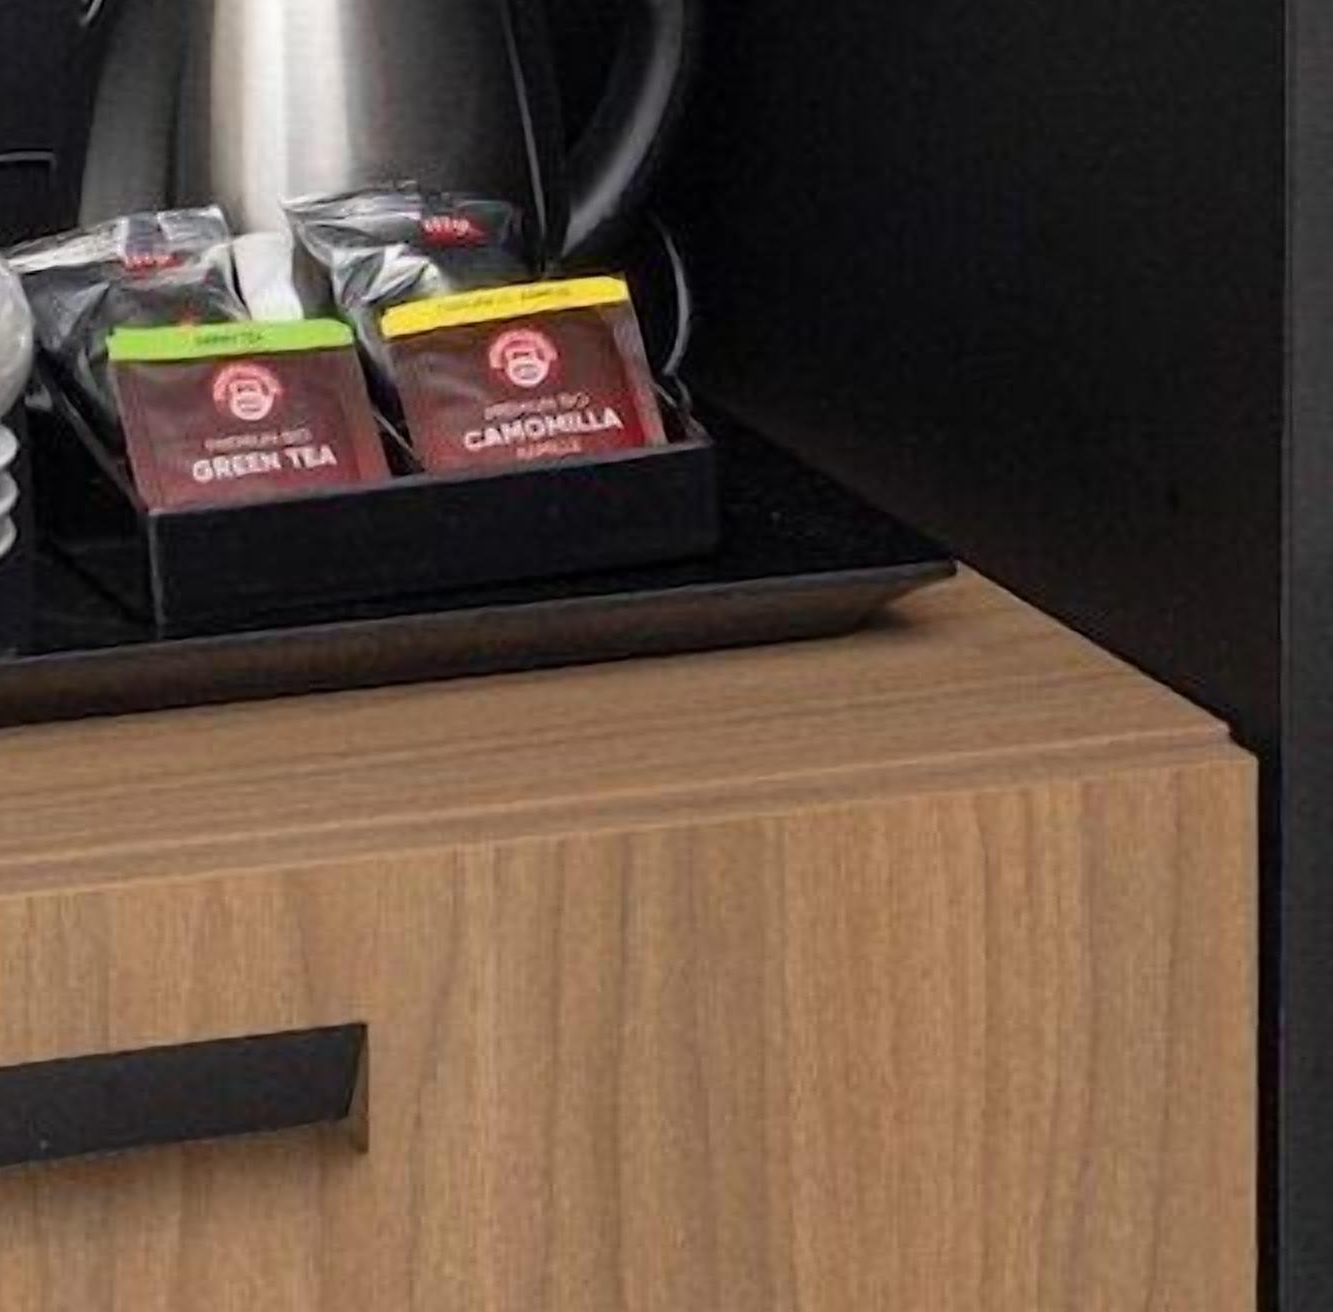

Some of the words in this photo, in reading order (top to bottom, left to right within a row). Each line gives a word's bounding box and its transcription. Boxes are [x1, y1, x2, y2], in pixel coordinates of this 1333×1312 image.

[464, 407, 624, 452] CAMOMILLA
[192, 452, 282, 483] GREEN
[284, 443, 338, 469] TEA
